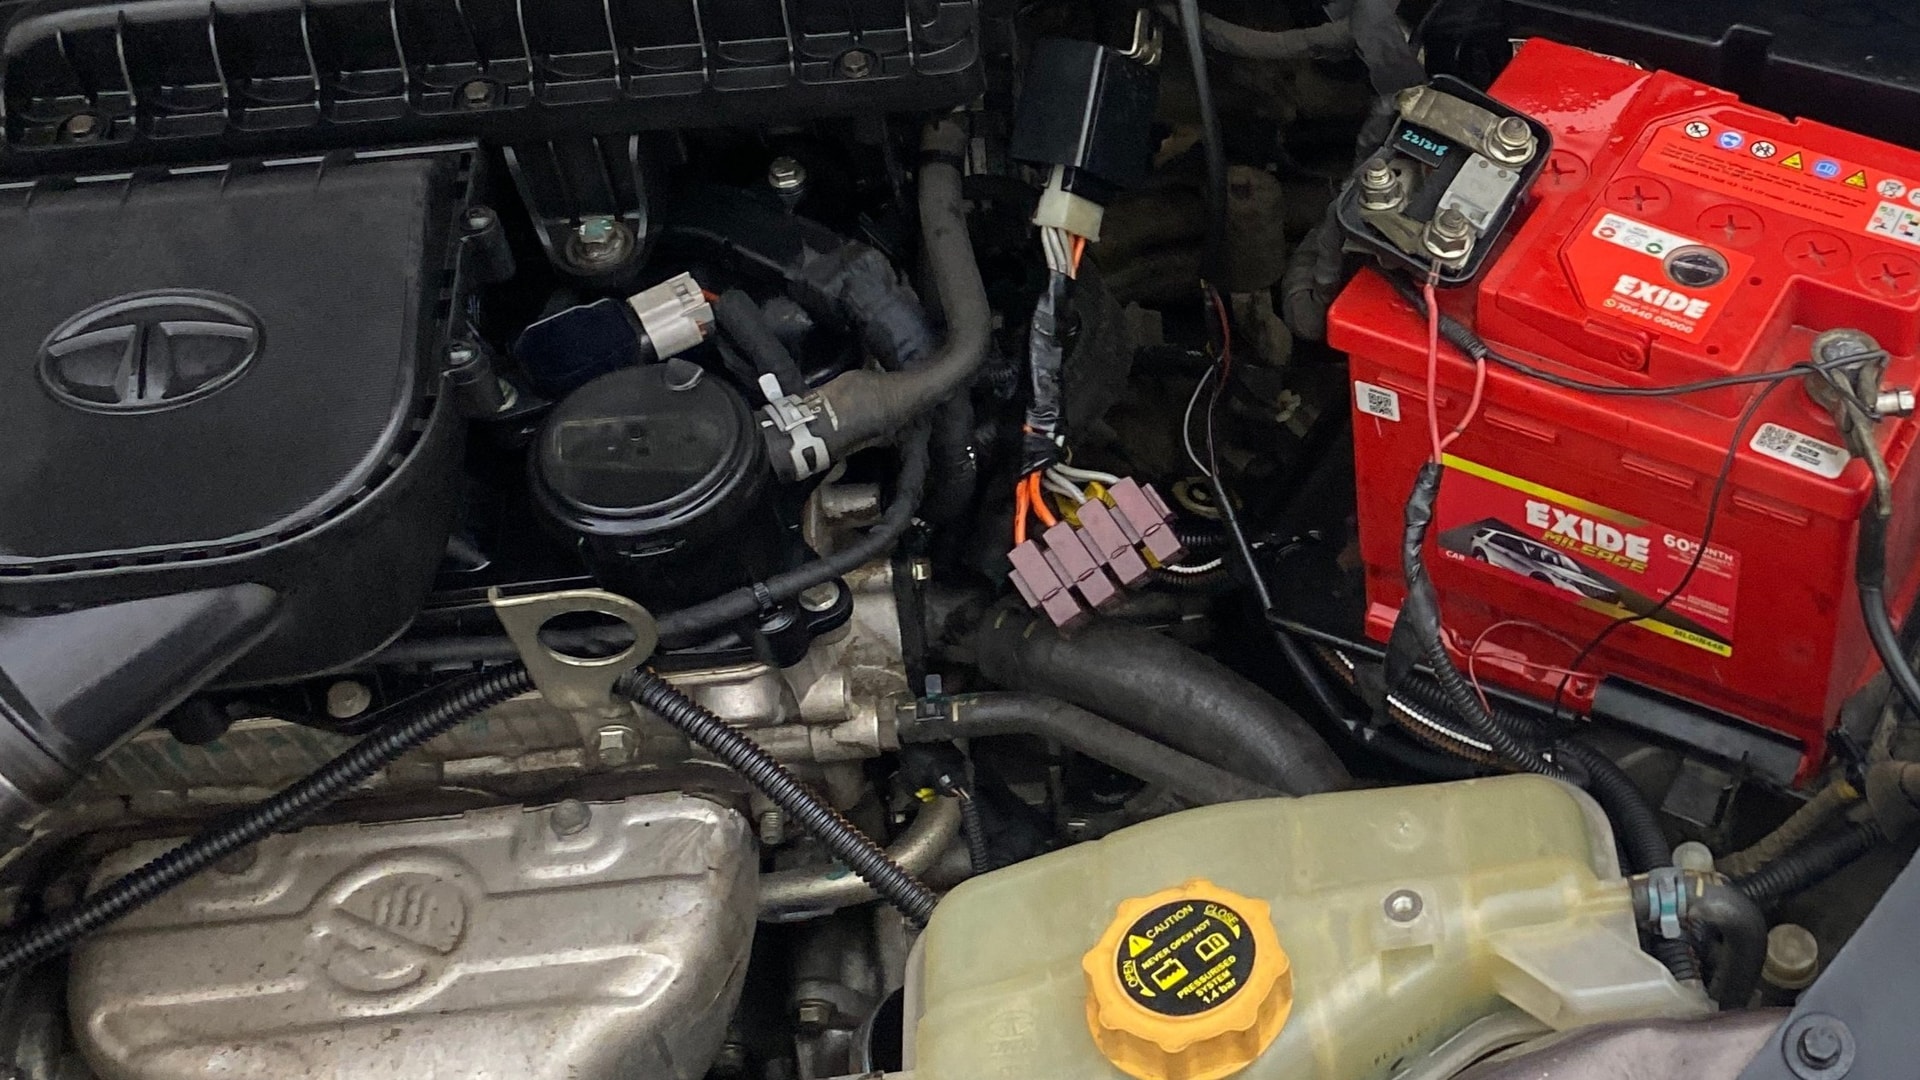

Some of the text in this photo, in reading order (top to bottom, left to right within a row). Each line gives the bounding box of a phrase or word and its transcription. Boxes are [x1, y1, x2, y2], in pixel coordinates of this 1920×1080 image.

[1614, 274, 1711, 319] EXIDE
[1525, 500, 1650, 562] EXIDE
[1446, 550, 1465, 561] CAR
[1543, 531, 1648, 574] MILEAGE
[1146, 905, 1194, 938] CAUTION
[1204, 904, 1239, 926] CLOSE
[1141, 919, 1211, 970] NEVER OPEN HOT
[1123, 960, 1138, 987] OPEN
[1177, 955, 1236, 999] PRESSURISED
[1195, 969, 1231, 997] SYSTEM
[1203, 978, 1236, 1003] 1.4 bar
